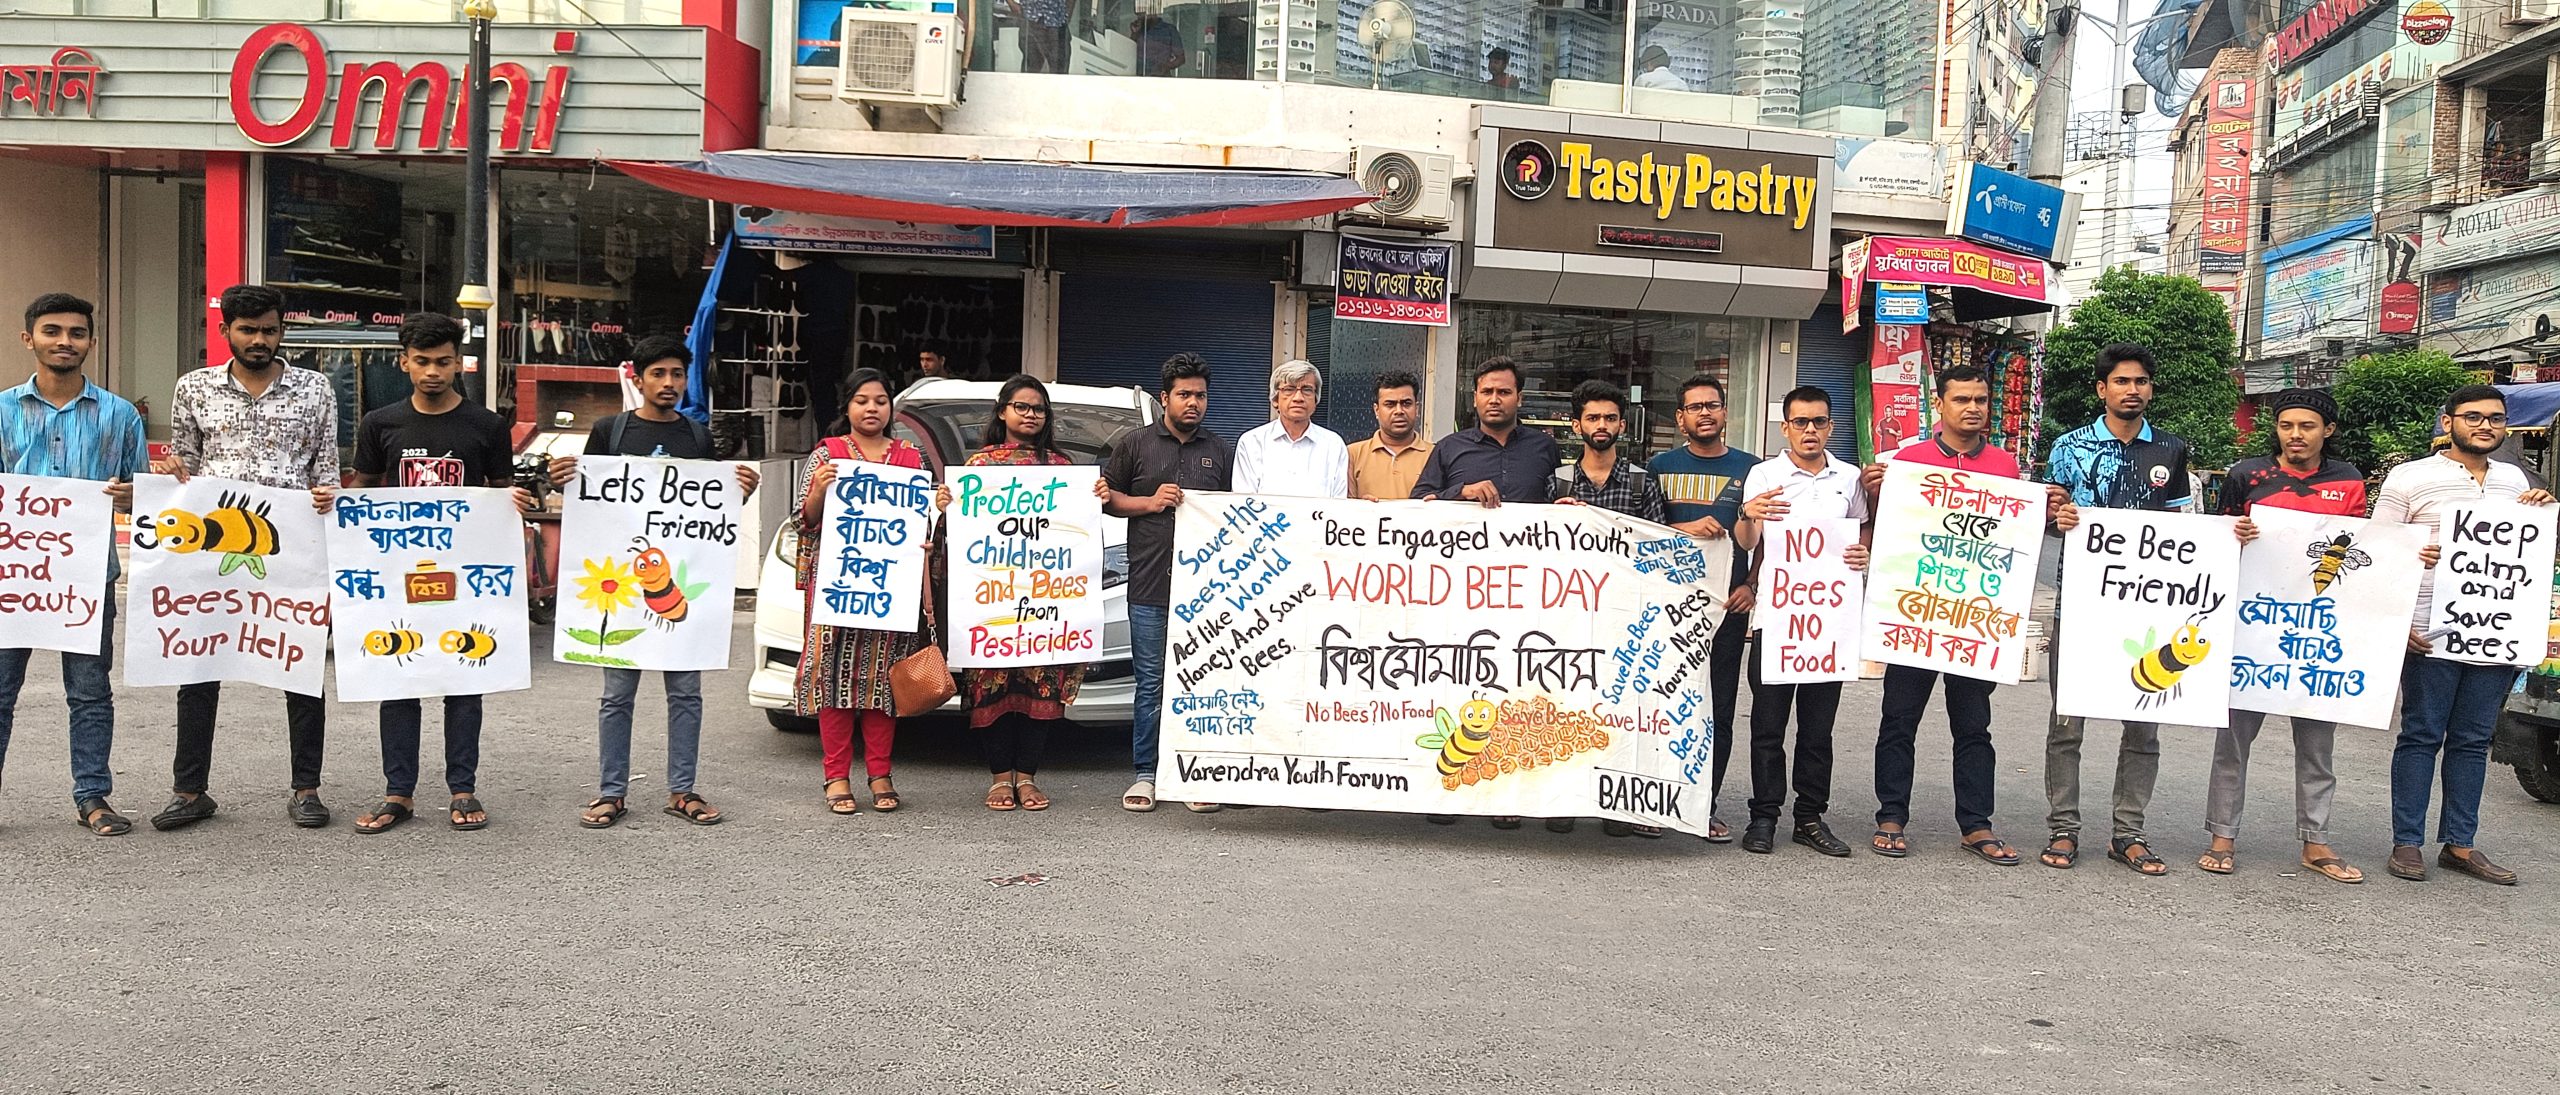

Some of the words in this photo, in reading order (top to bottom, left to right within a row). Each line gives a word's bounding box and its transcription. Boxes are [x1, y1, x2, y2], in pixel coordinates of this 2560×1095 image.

[1648, 2, 1719, 25] PRADA
[0, 46, 102, 114] মনি
[230, 22, 580, 153] Omni
[1560, 141, 1681, 220] Tasty
[1683, 153, 1817, 230] Pastry
[2456, 208, 2502, 238] ROYAL
[2504, 193, 2560, 226] CAPITA
[1345, 241, 1357, 260] এই
[1398, 251, 1414, 266] তলা
[1875, 253, 1913, 273] সুবিধা
[1915, 258, 1950, 273] ডাবল
[1343, 268, 1372, 297] ভাড়া
[1374, 272, 1411, 297] দেওয়া
[1414, 267, 1445, 300] হইবে
[2485, 278, 2513, 297] ROYAL
[325, 310, 357, 322] Omni
[372, 312, 405, 324] Omni
[1338, 300, 1444, 320] ০১৭১৬-১৪৩০২৮
[401, 448, 428, 457] 2023
[15, 486, 72, 518] for
[659, 465, 724, 510] Bee
[957, 473, 1068, 517] Protect
[1920, 472, 2034, 518] কীটনাশক
[367, 525, 453, 553] ব্যবহার
[645, 510, 738, 546] Friends
[998, 516, 1050, 541] our
[1178, 527, 1233, 575] Save
[1222, 497, 1267, 534] the
[1377, 517, 1489, 560] Engaged
[1499, 520, 1559, 550] with
[1786, 526, 1824, 563] NO
[1942, 511, 2002, 541] থেকে
[2086, 522, 2126, 555] Be
[2138, 523, 2197, 565] Bee
[2452, 509, 2539, 559] Keep
[1218, 537, 1266, 580] Save
[1259, 512, 1291, 541] the
[1920, 533, 2029, 573] আমাদের
[461, 564, 517, 597] কর
[837, 547, 898, 589] বিশ্ব
[975, 571, 1014, 604] and
[1029, 569, 1088, 600] Bees
[1225, 547, 1291, 611] World
[1324, 560, 1451, 607] WORLD
[1466, 564, 1529, 610] BEE
[1541, 568, 1610, 612] DAY
[1915, 554, 1968, 594] শিশু
[1981, 572, 2002, 597] ও
[0, 585, 98, 628] eauty
[152, 585, 243, 618] Bees
[247, 590, 331, 626] need
[822, 580, 893, 618] বাঁচাও
[1772, 567, 1846, 609] Bees
[2100, 564, 2227, 613] Friendly
[2460, 581, 2517, 600] and
[1013, 596, 1059, 623] from
[1627, 602, 1662, 640] Bees
[1665, 589, 1711, 627] Bees
[1788, 613, 1822, 641] NO
[2238, 592, 2341, 640] মৌমাছি
[2442, 601, 2512, 630] Save
[158, 627, 229, 659] Your
[237, 622, 304, 671] Help
[968, 621, 1093, 659] Pesticides
[1173, 629, 1199, 666] Act
[1197, 611, 1233, 644] like
[1231, 608, 1270, 650] And
[1669, 609, 1713, 653] Need
[2278, 628, 2344, 663] বাঁচাও
[2444, 631, 2520, 662] Bees
[1315, 625, 1381, 689] বিশ্ব
[1380, 630, 1508, 693] মৌমাছি
[1612, 639, 1641, 668] The
[1642, 639, 1666, 670] Die
[1652, 663, 1688, 699] Your
[1686, 638, 1712, 671] Help
[1601, 665, 1630, 705] Save
[2230, 655, 2291, 692] জীবন
[2298, 660, 2365, 698] বাঁচাও
[1306, 701, 1329, 723] No
[1380, 702, 1400, 723] No
[1402, 699, 1434, 722] Food
[1500, 700, 1545, 727] Save
[1592, 702, 1636, 732] Save
[1638, 706, 1670, 735] Life
[1668, 728, 1698, 760] Bee
[1683, 716, 1714, 785] Friends
[1284, 756, 1334, 786] Youth
[1337, 761, 1409, 793] Forum
[1599, 774, 1682, 820] BARCIK
